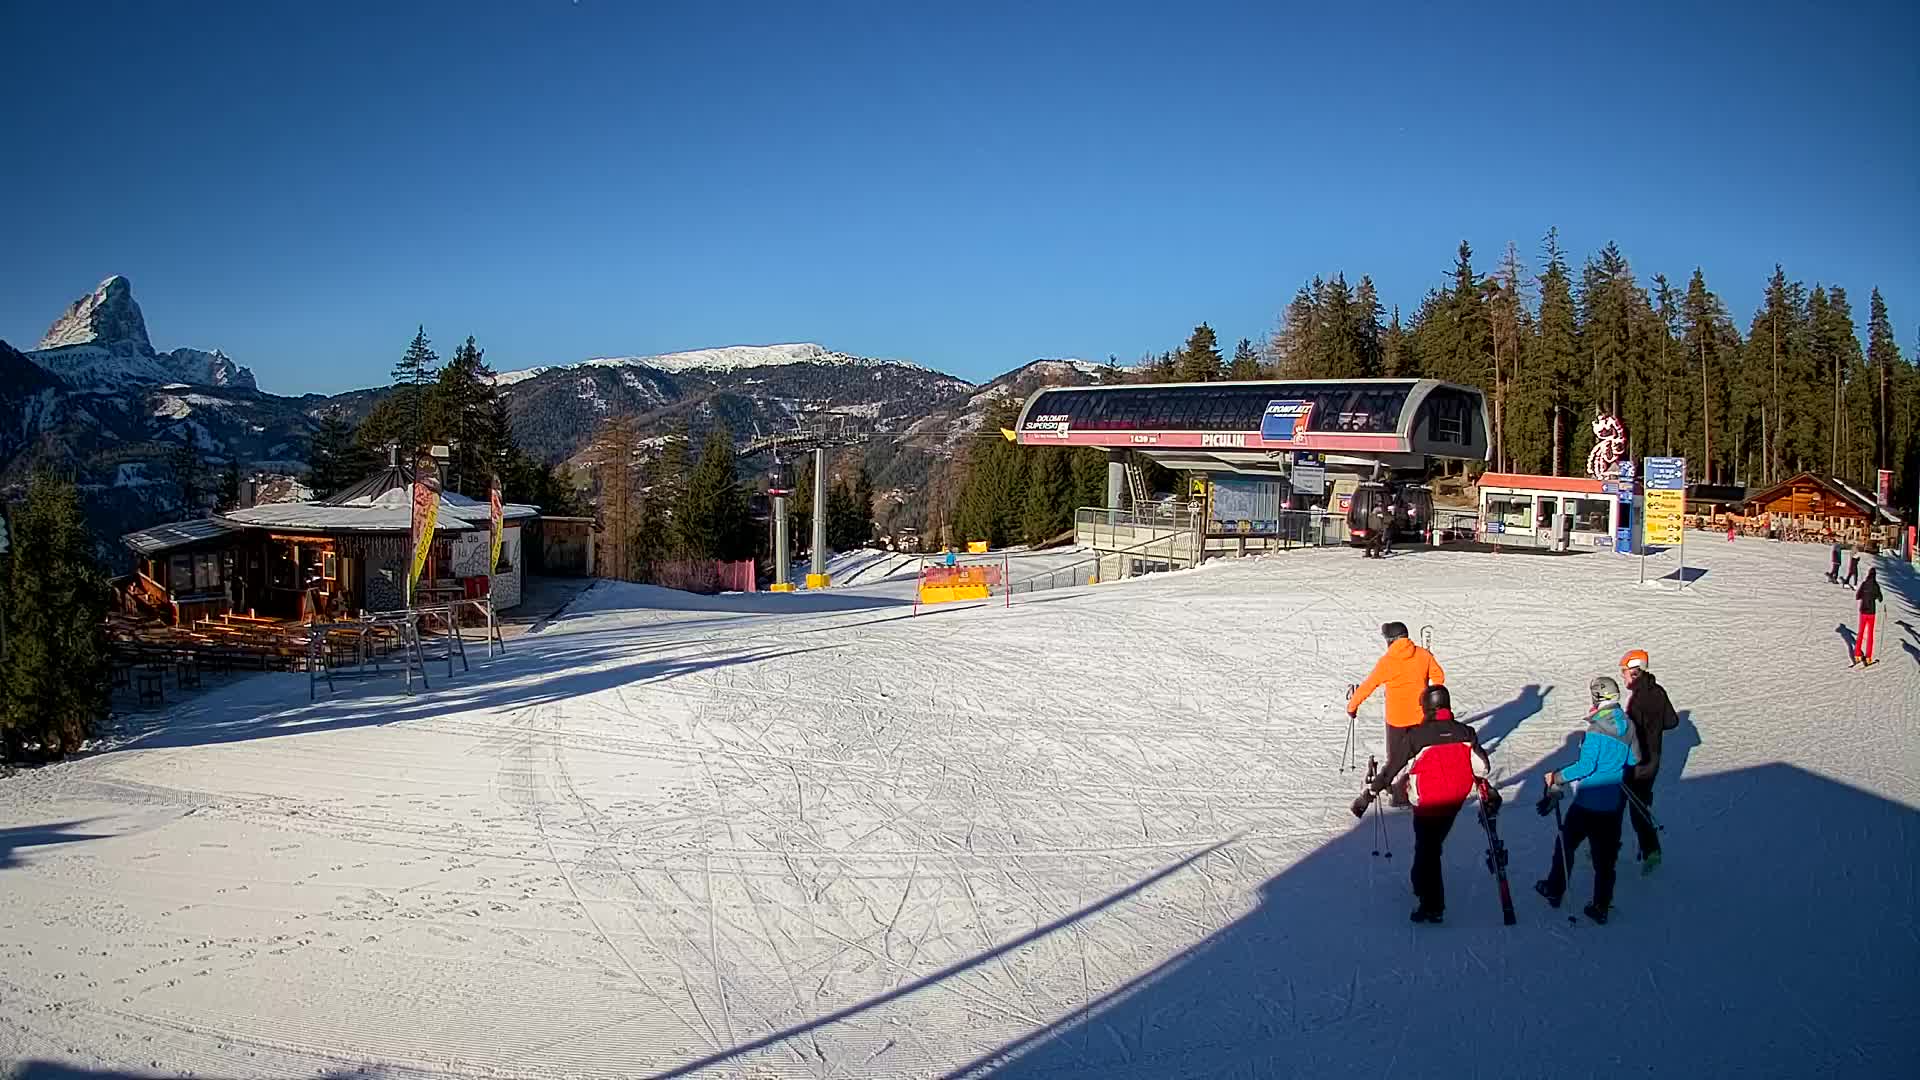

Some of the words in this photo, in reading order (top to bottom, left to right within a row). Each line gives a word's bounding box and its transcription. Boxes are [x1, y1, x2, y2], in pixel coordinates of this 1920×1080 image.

[1036, 414, 1069, 422] DOLOMITI
[1025, 422, 1059, 430] SUPERSKI
[1202, 434, 1245, 447] PICULIN
